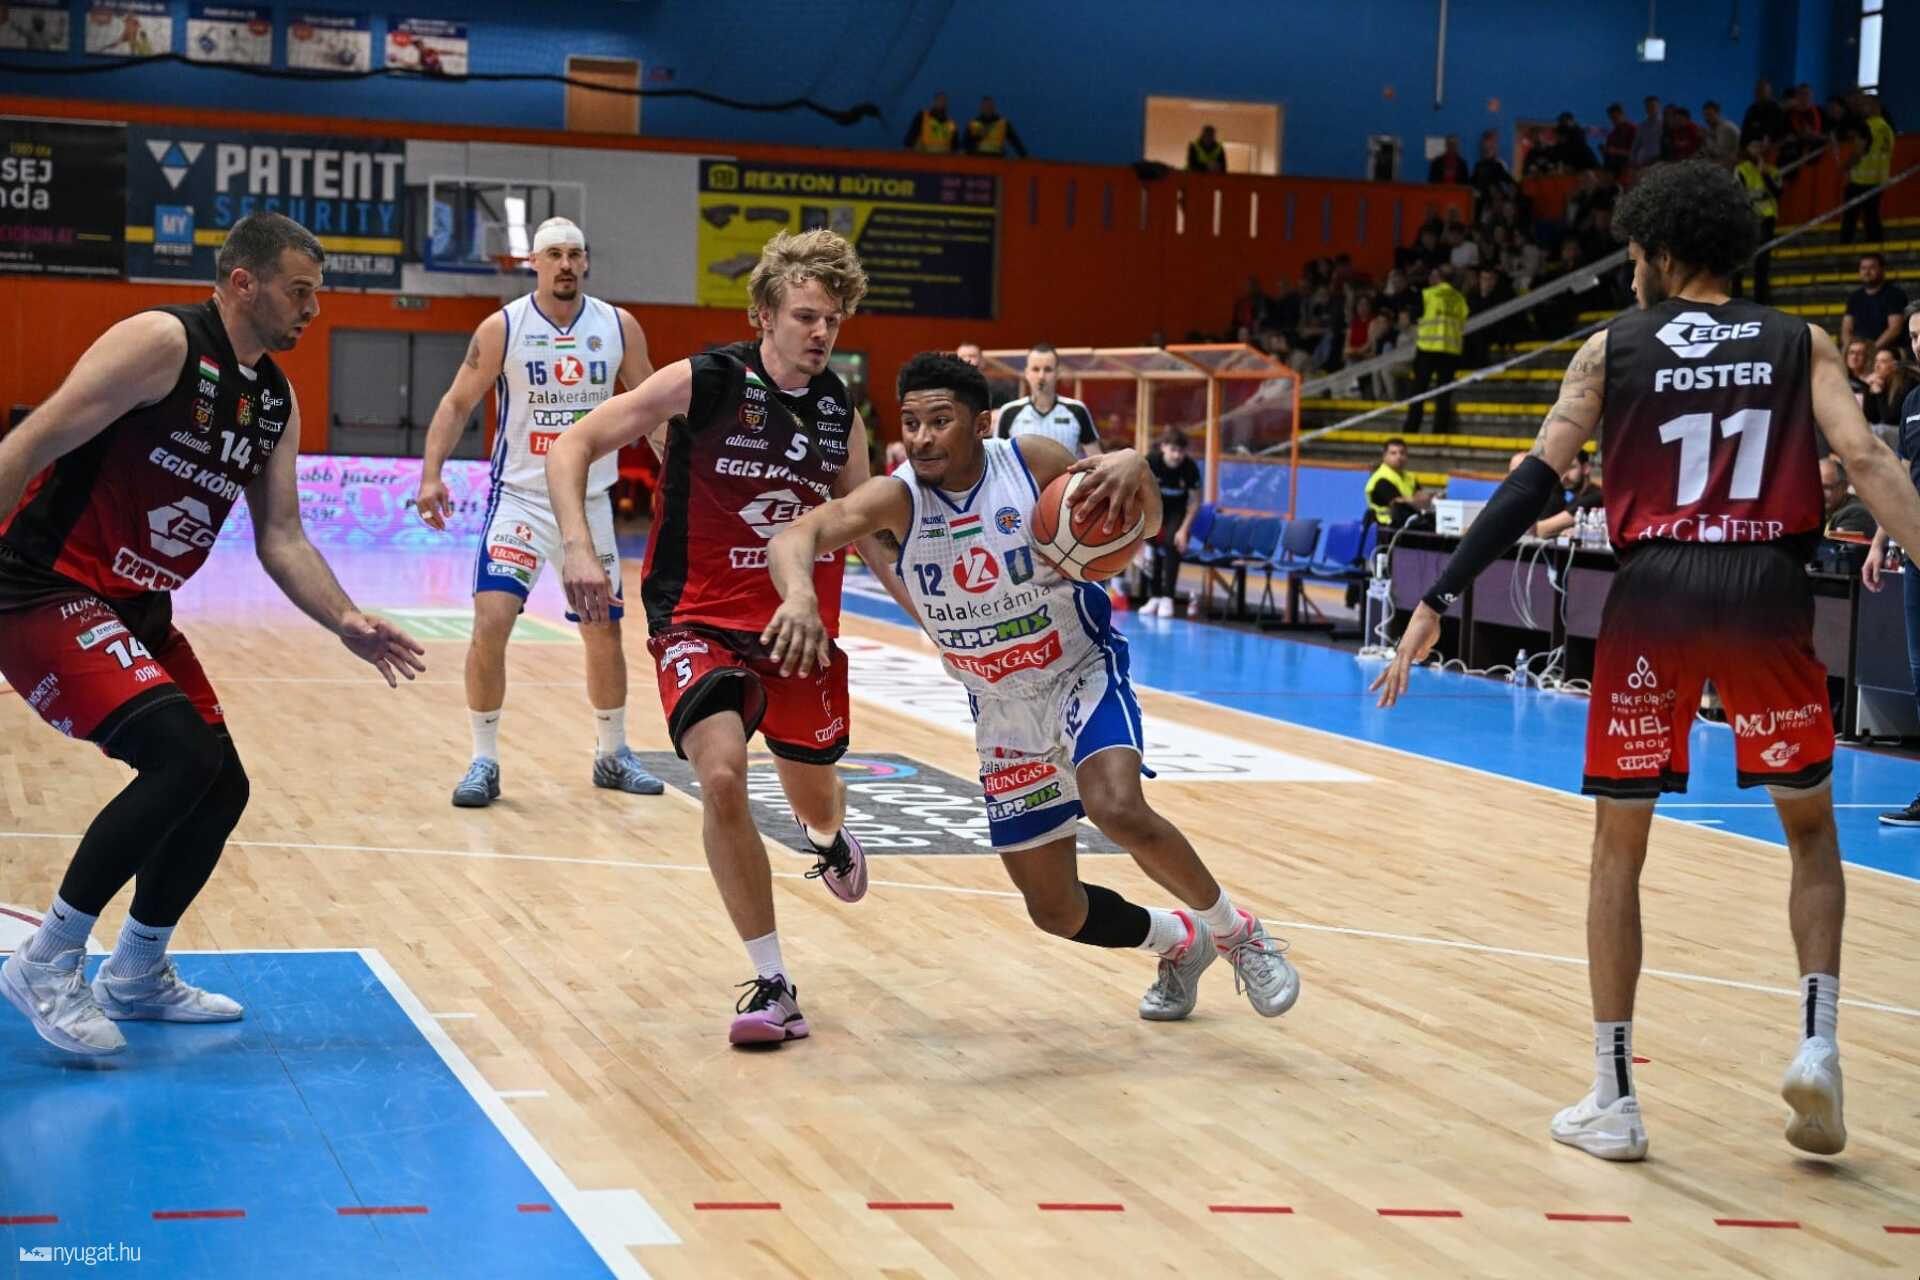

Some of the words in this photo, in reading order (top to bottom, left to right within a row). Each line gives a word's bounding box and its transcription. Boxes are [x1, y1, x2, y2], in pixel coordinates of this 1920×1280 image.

[216, 143, 402, 199] PATENT
[744, 171, 834, 192] REXTON
[1689, 321, 1762, 342] EGIS
[525, 361, 548, 386] 15
[1654, 362, 1773, 393] FOSTER
[220, 430, 252, 470] 14
[726, 434, 769, 450] aliante
[784, 432, 809, 461] 5
[1658, 408, 1772, 507] 11
[149, 447, 198, 480] EGIS
[715, 457, 763, 478] EGIS
[914, 563, 946, 597] 12
[923, 584, 1051, 623] Zalakerámia
[105, 636, 152, 669] 14
[675, 656, 693, 689] 5
[1607, 714, 1671, 738] MIEL
[986, 764, 1049, 792] HUNGAST
